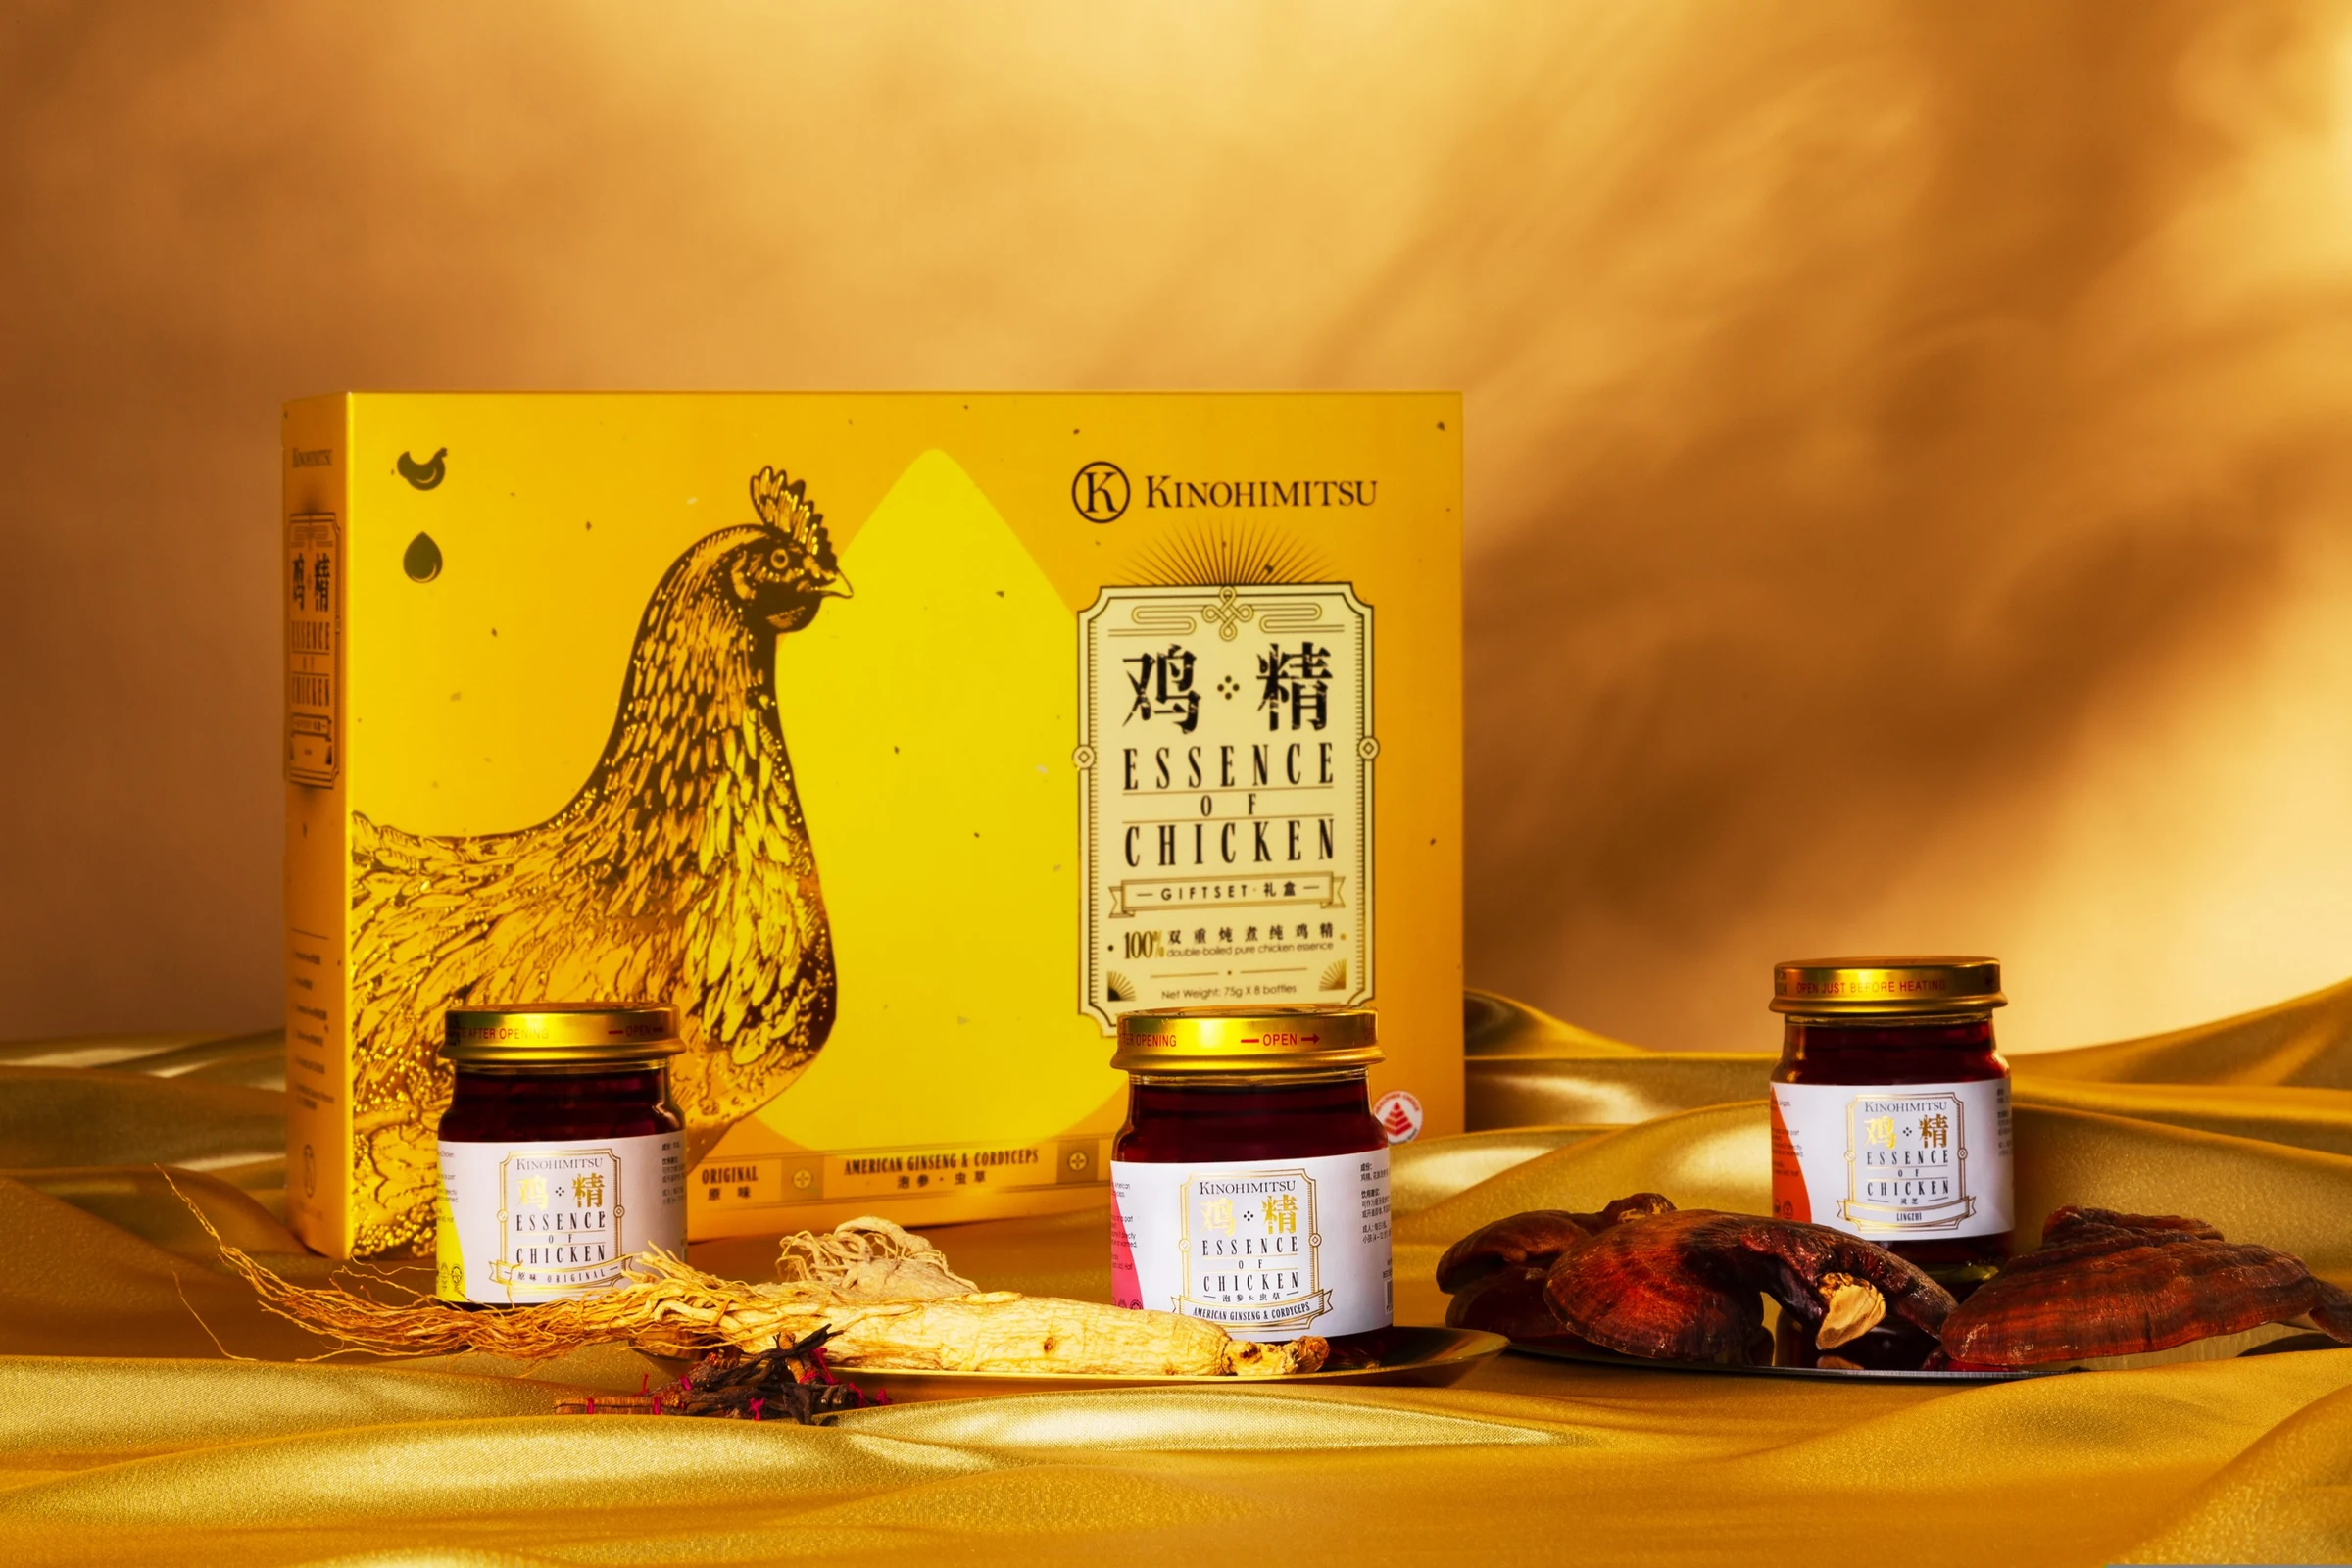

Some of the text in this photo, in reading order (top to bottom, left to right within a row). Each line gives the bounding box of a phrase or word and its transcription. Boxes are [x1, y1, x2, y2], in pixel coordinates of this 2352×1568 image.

[1145, 475, 1378, 508] KINOHIMITSU
[1122, 641, 1334, 734] 鸡 精
[1123, 743, 1334, 790] ESSENCE
[1200, 793, 1257, 817] OF
[1124, 818, 1334, 867] CHICKEN
[1124, 930, 1164, 959] 100%
[1166, 942, 1334, 957] double-boiled pure chicken essence
[1161, 990, 1180, 1000] Net
[1182, 986, 1221, 1000] Weight:
[1224, 986, 1244, 998] 75g
[1253, 985, 1260, 995] 8
[1263, 983, 1297, 995] bottles
[1796, 980, 1947, 993] OPEN JUST BEFORE HEATING
[467, 1027, 496, 1040] AFTER
[499, 1027, 549, 1040] OPENING
[625, 1024, 651, 1037] OPEN
[1263, 1032, 1298, 1046] OPEN
[1136, 1033, 1176, 1047] OPENING
[1865, 1101, 1947, 1112] KINOHIMITSU
[1918, 1113, 1949, 1149] 精
[516, 1157, 604, 1170] KINOHIMITSU
[844, 1149, 1039, 1176] AMERICAN GINSENG & CORDYCEPS
[1867, 1149, 1948, 1165] ESSENCE
[702, 1166, 759, 1185] ORIGINAL
[1897, 1168, 1920, 1177] OF
[571, 1172, 605, 1208] 精
[1200, 1180, 1296, 1195] KINOHIMITSU
[1867, 1179, 1949, 1196] CHICKEN
[516, 1211, 606, 1232] ESSENCE
[1261, 1194, 1298, 1234] 精
[1896, 1212, 1923, 1222] LINGZHI
[548, 1234, 572, 1244] OF
[1202, 1236, 1298, 1255] ESSENCE
[516, 1245, 605, 1264] CHICKEN
[1238, 1259, 1263, 1270] OF
[547, 1268, 606, 1283] ORIGINAL
[1203, 1272, 1298, 1292] CHICKEN
[1193, 1301, 1311, 1321] AMERICAN GINSENG & CORDYCEPS
